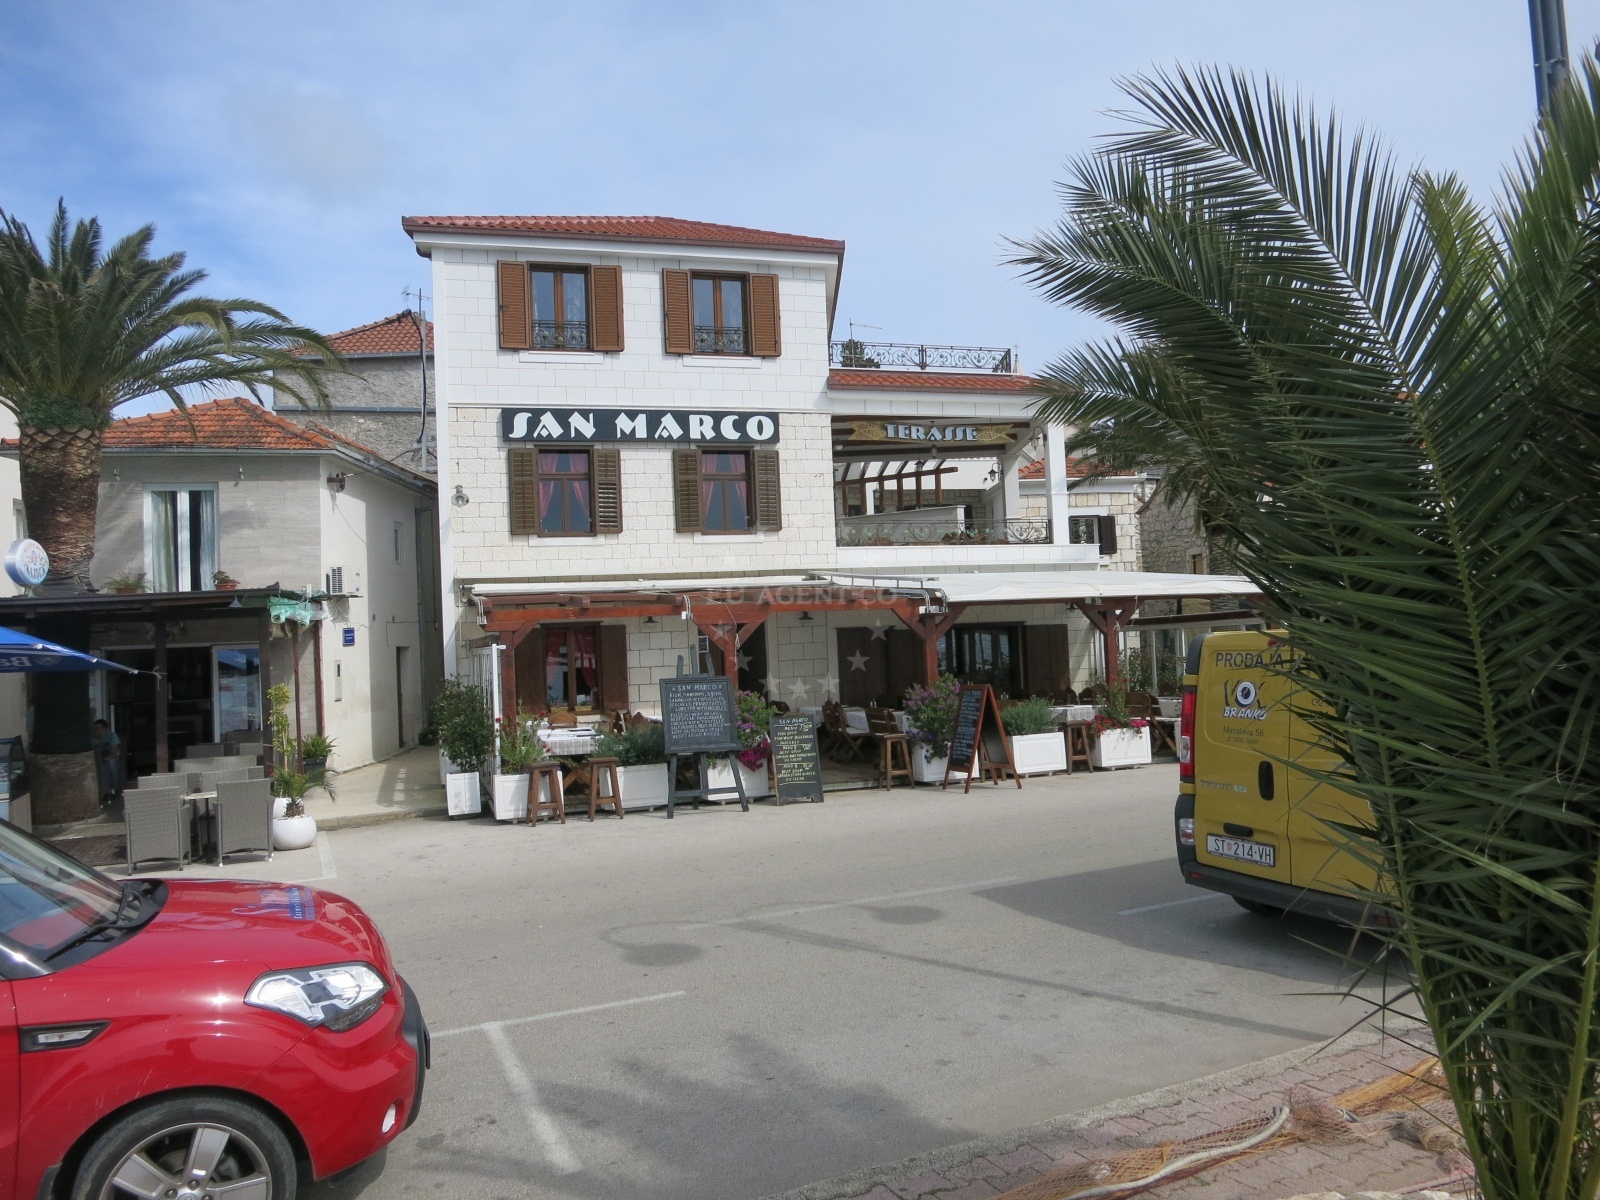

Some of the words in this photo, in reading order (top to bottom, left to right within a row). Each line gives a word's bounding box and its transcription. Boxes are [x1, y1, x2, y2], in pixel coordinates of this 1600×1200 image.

[508, 410, 597, 440] SAN
[614, 412, 775, 441] MARCO
[884, 423, 978, 441] TERASSE
[1223, 706, 1267, 720] BRANKO
[1255, 728, 1265, 737] 56
[1214, 838, 1227, 853] ST
